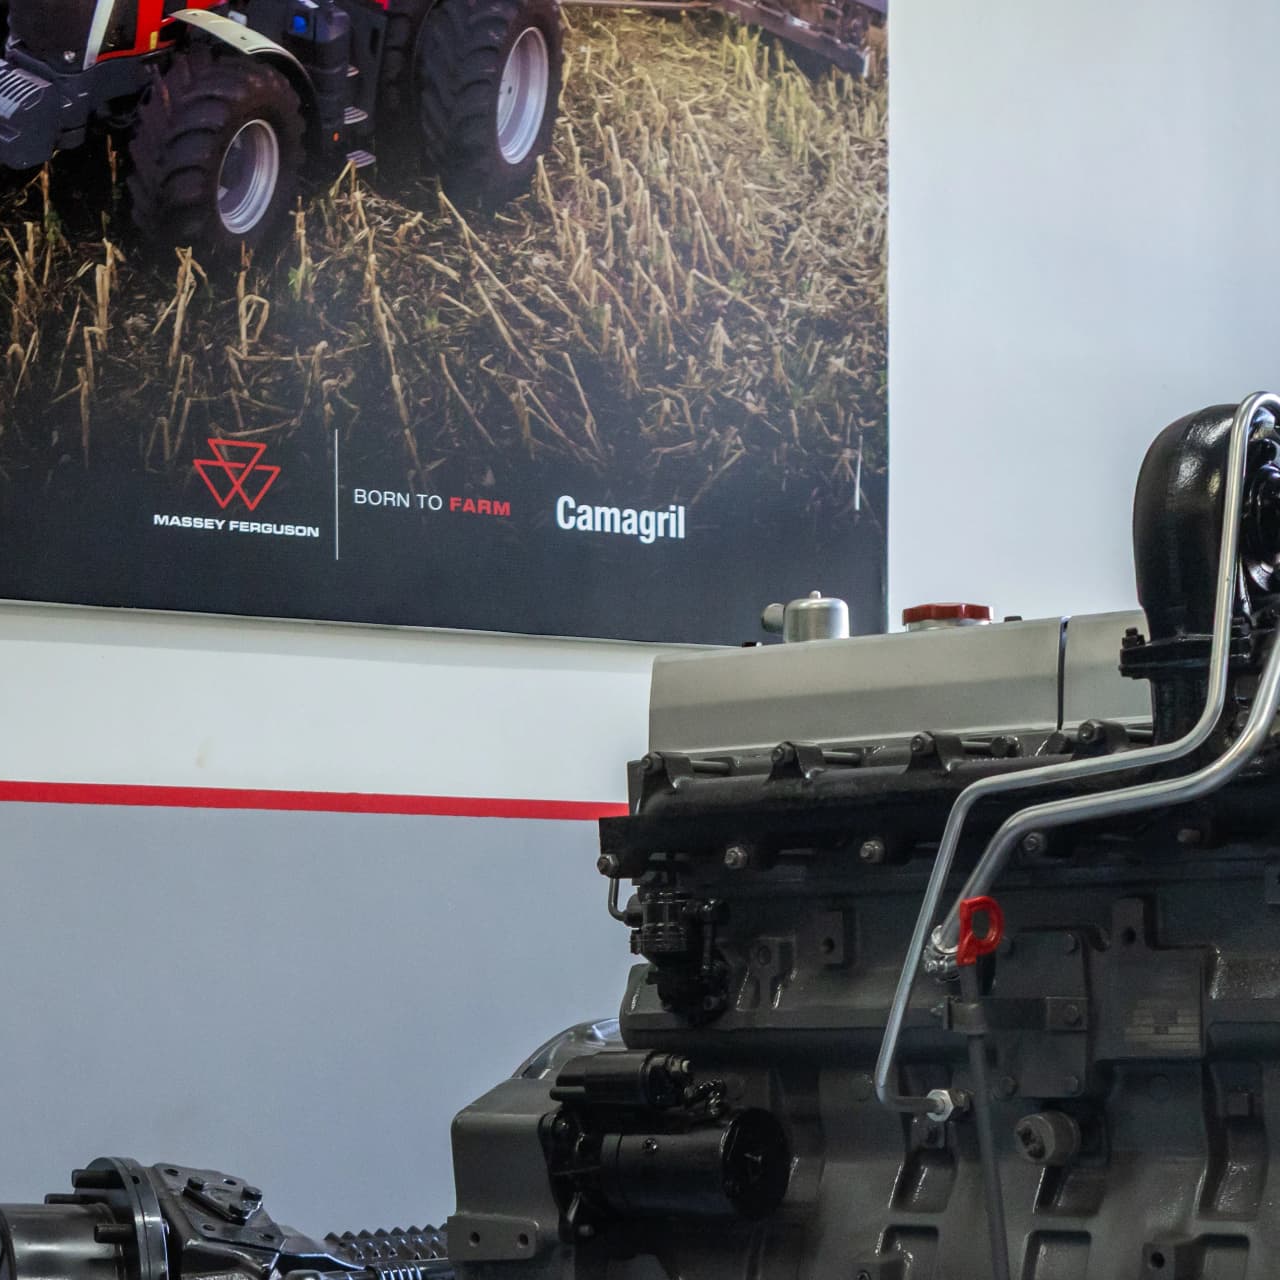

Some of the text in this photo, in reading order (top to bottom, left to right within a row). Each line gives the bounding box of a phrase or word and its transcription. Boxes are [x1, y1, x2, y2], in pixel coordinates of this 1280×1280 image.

[354, 488, 511, 516] BORN TO FARM
[153, 514, 319, 537] MASSEY FERGUSON
[556, 495, 685, 544] Camagril
